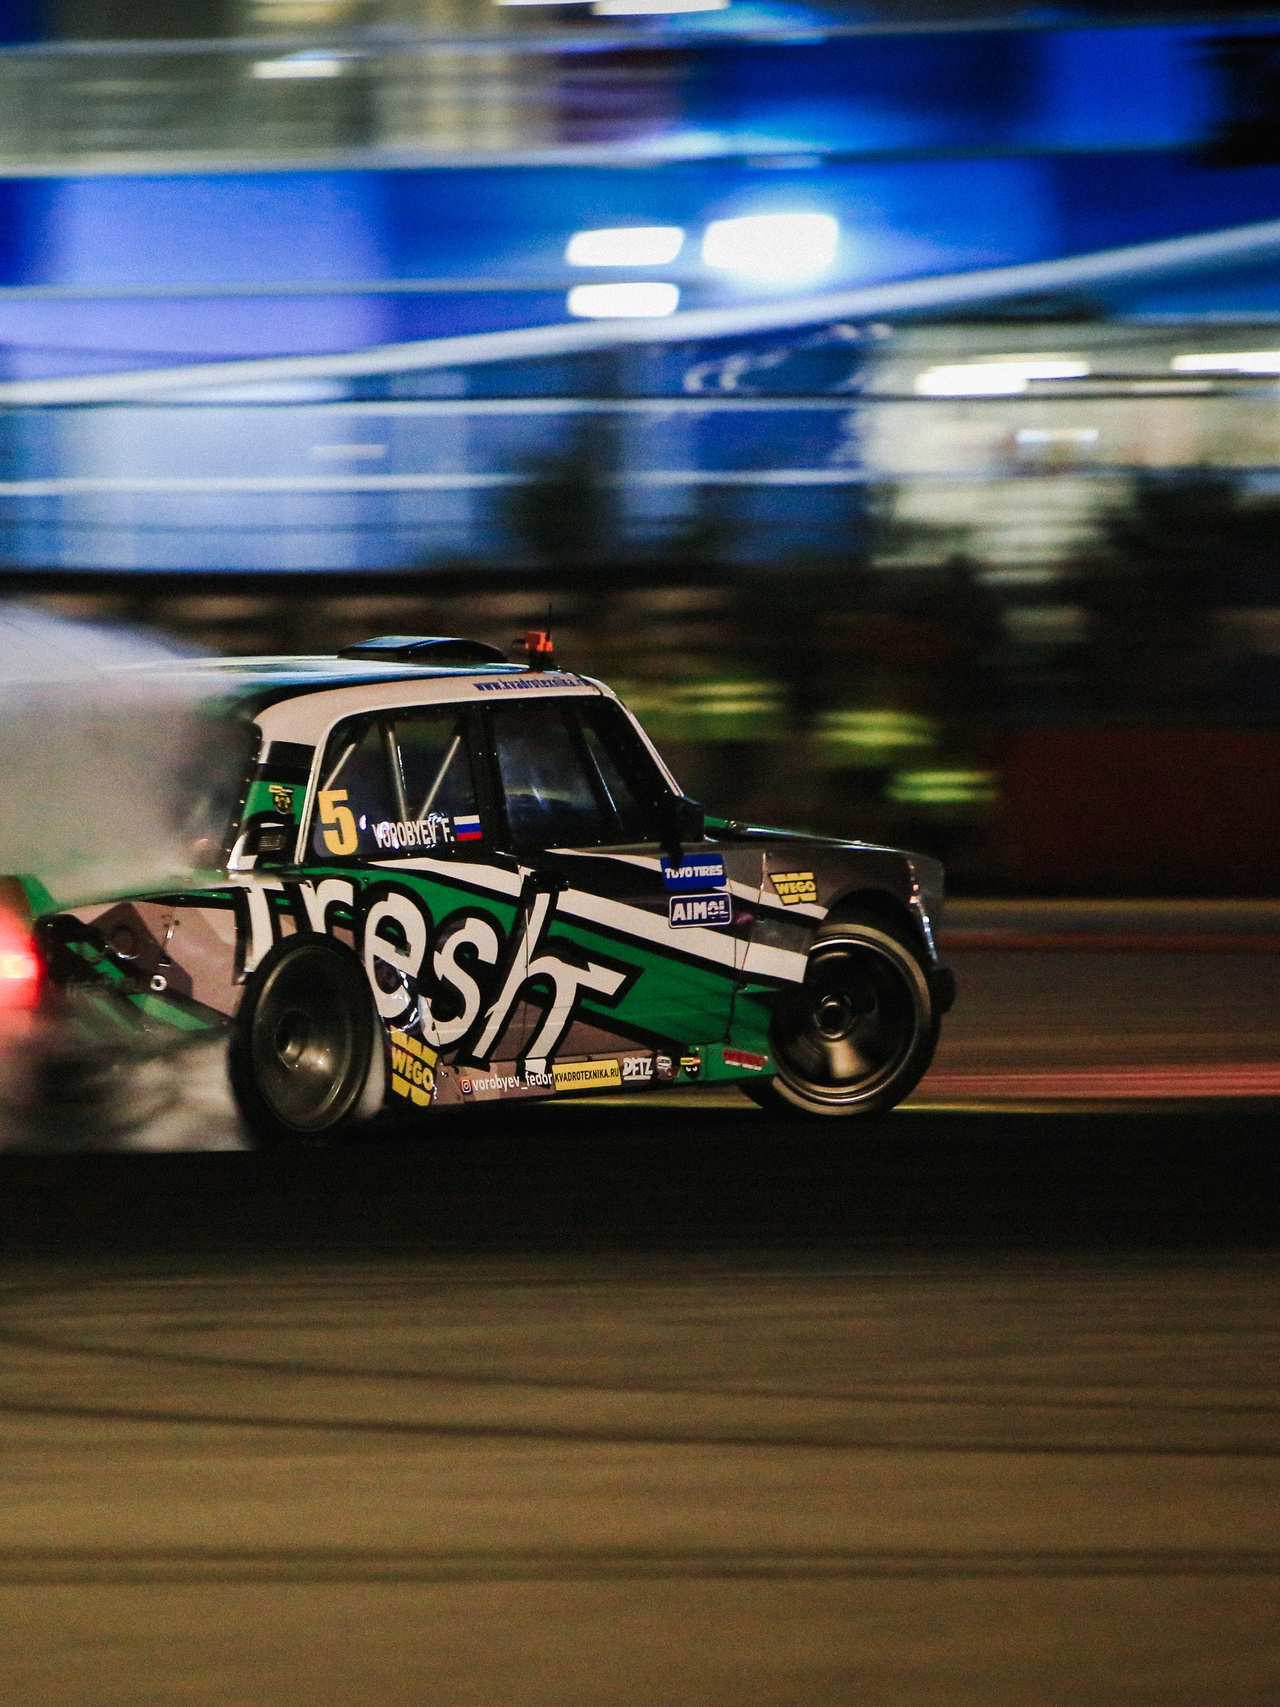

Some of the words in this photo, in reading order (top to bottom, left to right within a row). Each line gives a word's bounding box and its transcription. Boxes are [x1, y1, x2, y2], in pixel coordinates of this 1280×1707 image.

[318, 789, 358, 856] 5
[371, 819, 437, 848] VOROBYEV
[441, 817, 455, 843] F.
[665, 867, 693, 879] TOYO
[693, 865, 723, 877] TIRES
[775, 881, 817, 895] WEGO
[672, 900, 729, 921] AIMOL
[391, 1046, 434, 1091] WEGO
[554, 1067, 619, 1083] KVADROTEXNIKA.RU
[472, 1071, 552, 1093] vorobyev_fedor
